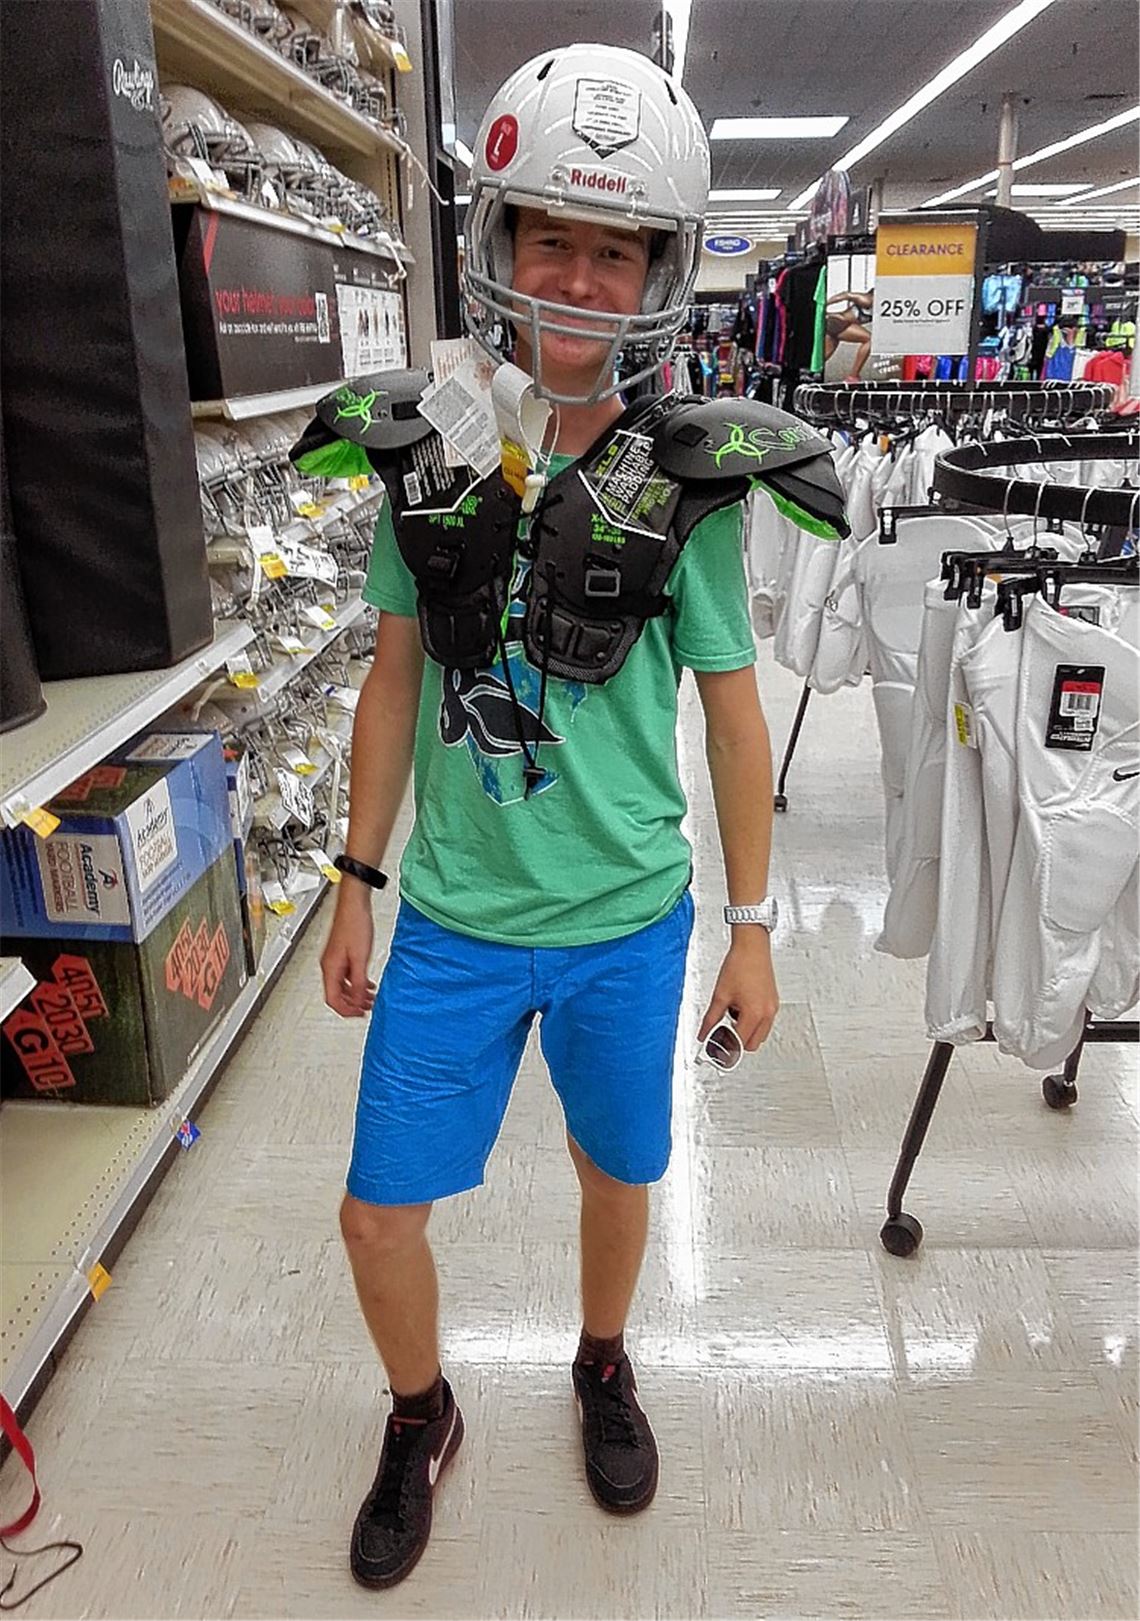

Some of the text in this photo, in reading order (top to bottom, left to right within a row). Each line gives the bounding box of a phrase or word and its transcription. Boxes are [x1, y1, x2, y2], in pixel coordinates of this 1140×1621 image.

[571, 168, 627, 193] Riddell
[886, 242, 964, 257] CLEARANCE
[215, 289, 241, 319] your
[880, 299, 964, 318] 25% OFF
[605, 443, 641, 494] MACHINE
[612, 440, 653, 500] WASHABLE
[621, 458, 655, 504] PADDING
[57, 841, 79, 910] FOOTBALL
[80, 842, 100, 917] Academy
